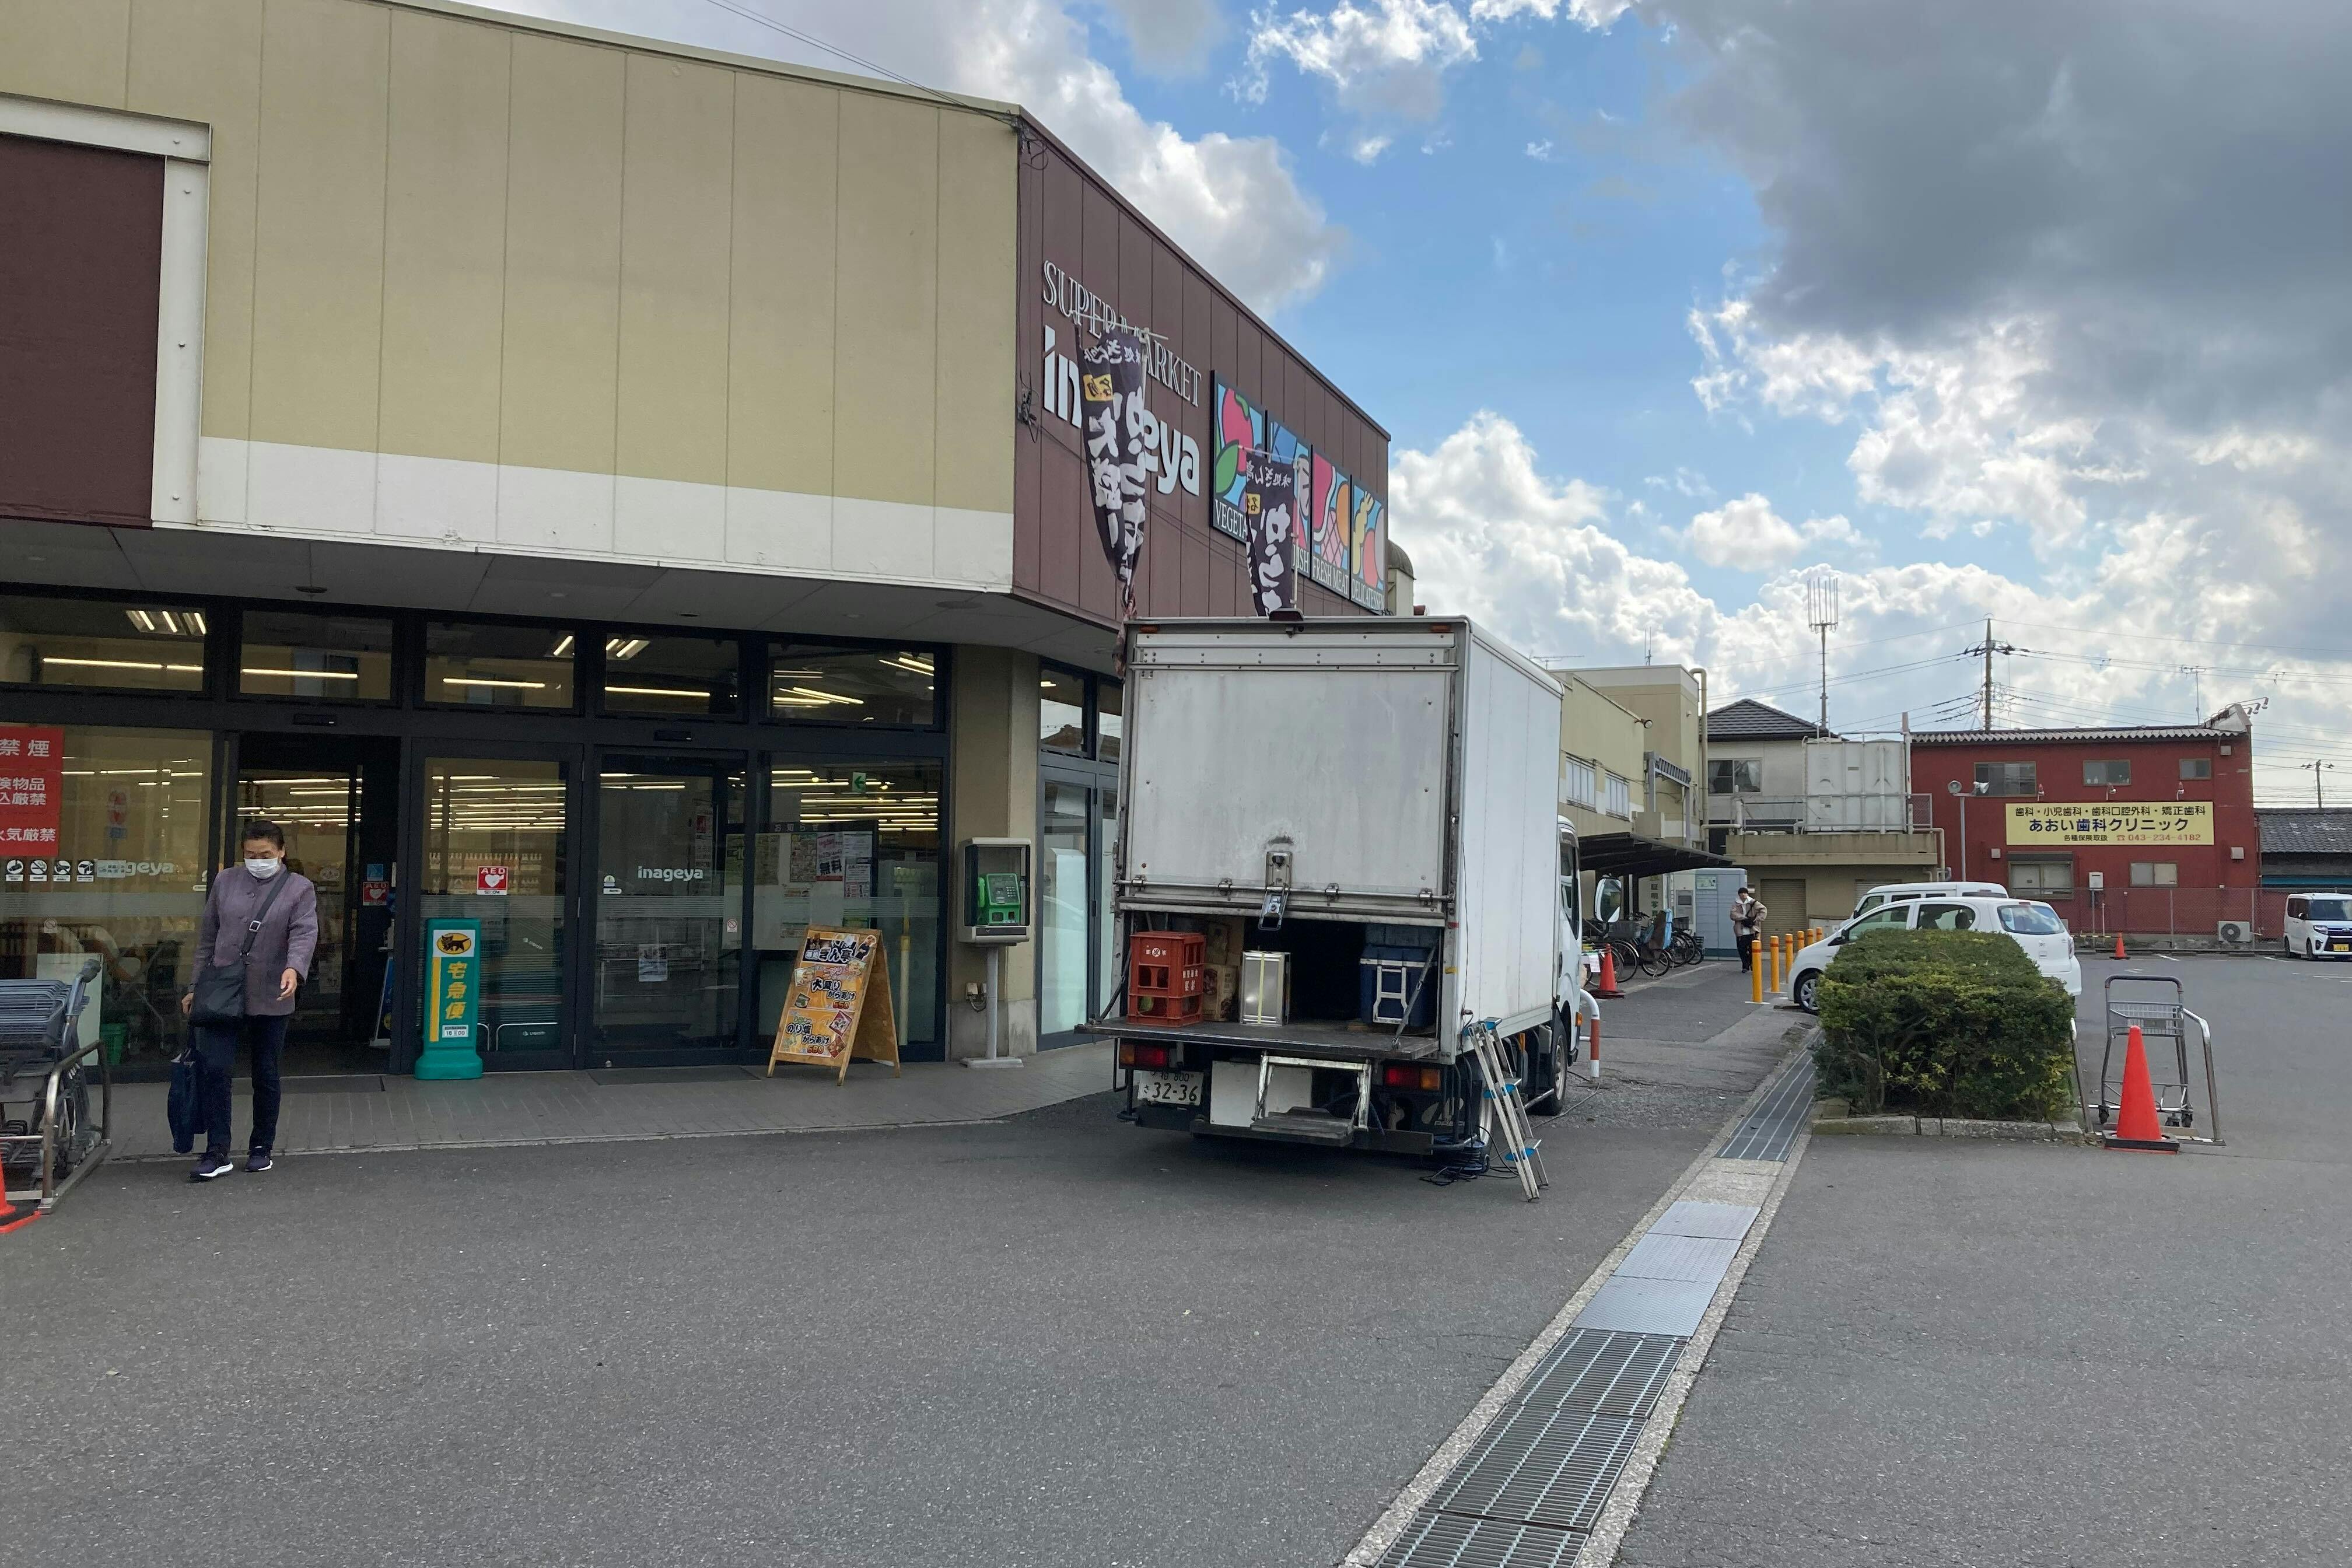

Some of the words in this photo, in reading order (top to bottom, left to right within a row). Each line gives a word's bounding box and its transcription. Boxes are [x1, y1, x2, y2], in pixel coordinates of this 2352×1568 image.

[1312, 556, 1332, 587] FRESH
[1332, 567, 1349, 595] MEAT
[2029, 818, 2189, 832] あおい歯科クリニック
[638, 866, 704, 882] inageya
[1152, 1082, 1198, 1102] 32-36
